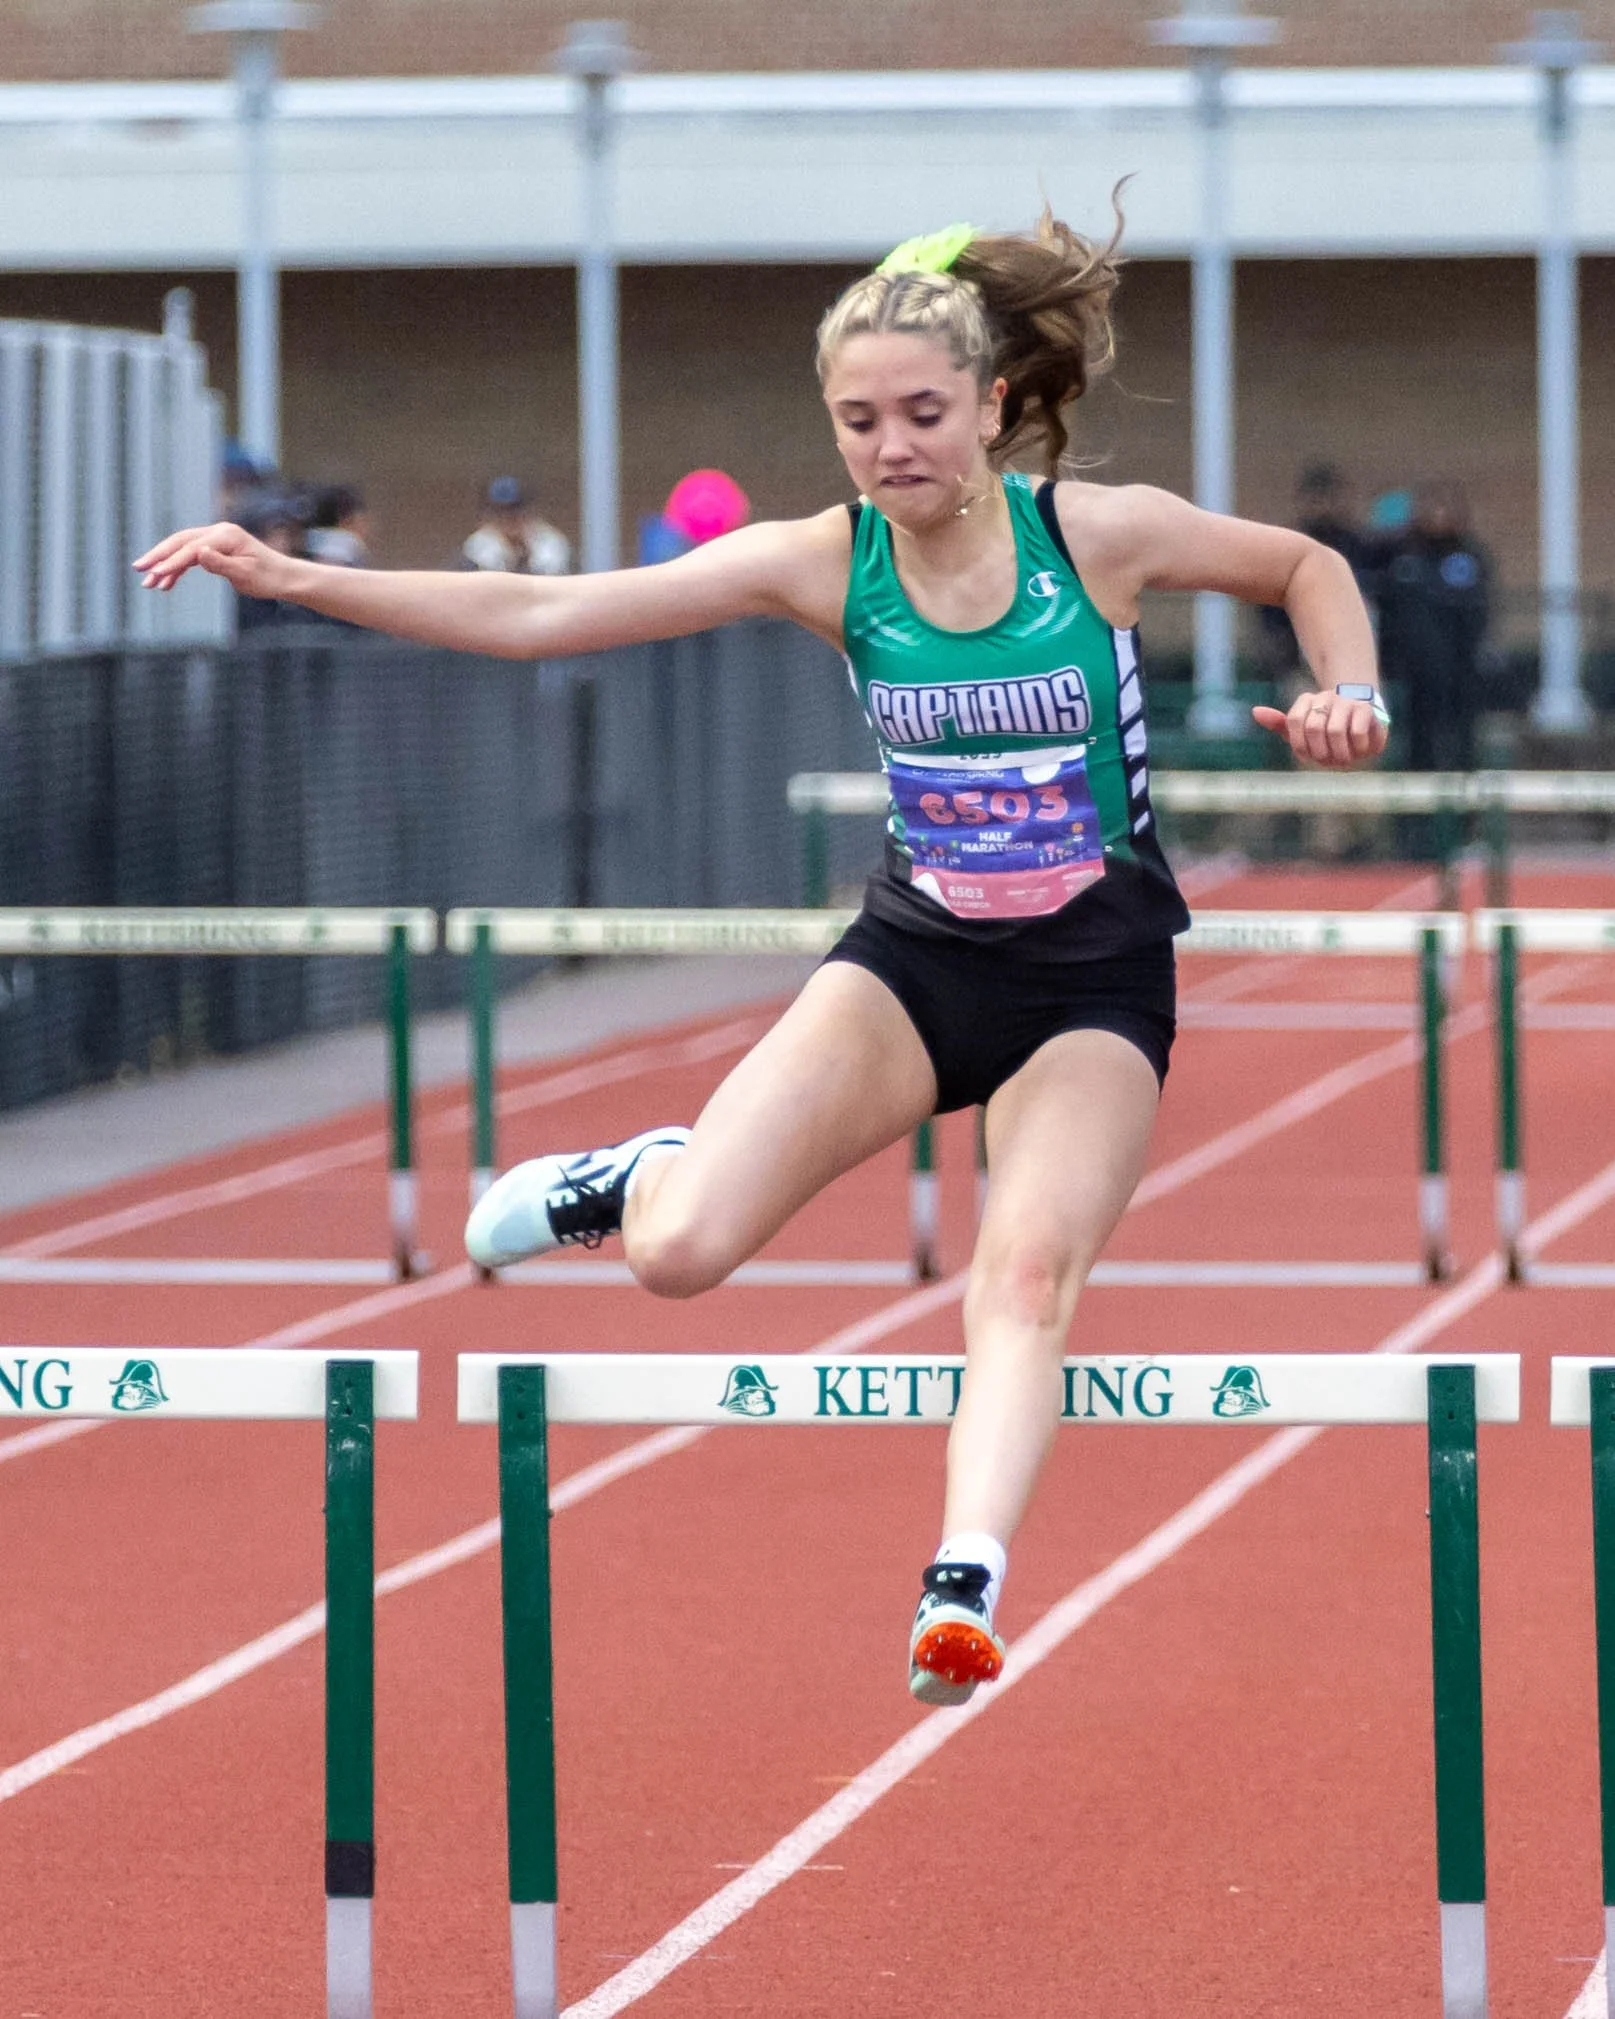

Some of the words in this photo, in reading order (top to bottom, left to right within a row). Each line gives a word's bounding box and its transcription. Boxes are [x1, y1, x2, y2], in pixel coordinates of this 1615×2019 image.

[868, 666, 1092, 746] CAPTAINS
[920, 784, 1068, 825] 6503
[961, 841, 1034, 853] MARATHON
[979, 832, 1012, 842] HALF
[948, 886, 984, 898] 6503
[813, 1366, 1174, 1417] KETTING
